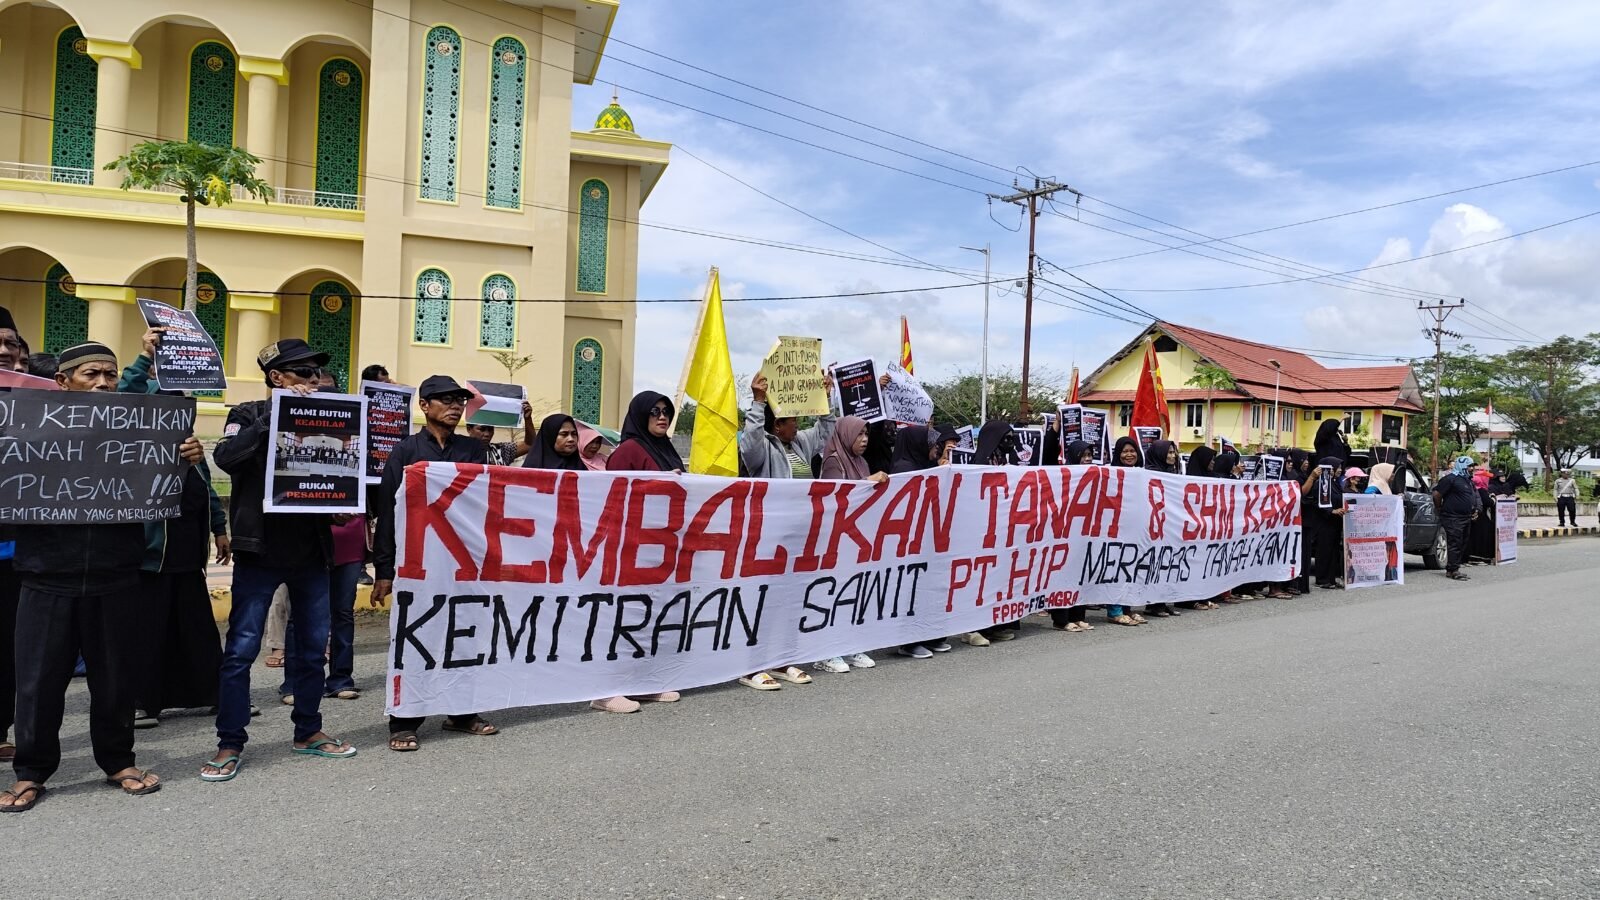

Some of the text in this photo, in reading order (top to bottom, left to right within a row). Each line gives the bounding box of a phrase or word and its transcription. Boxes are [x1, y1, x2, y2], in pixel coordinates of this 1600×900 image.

[778, 393, 808, 405] SCHEMES
[39, 404, 193, 431] KEMBALIKAN
[290, 407, 352, 418] KAMI BUTUH
[295, 418, 346, 428] KEADILAN
[0, 473, 135, 501] PLASMA
[299, 482, 335, 490] BUKAN
[286, 491, 346, 499] PESAKITAN
[0, 507, 78, 521] EMITRAAN
[83, 508, 114, 521] YANG
[398, 461, 963, 586] KEMBALIKAN
[980, 466, 1125, 549] TANAH
[1148, 479, 1166, 541] &
[1182, 483, 1236, 541] SHM
[394, 584, 769, 671] KEMITRAAN
[799, 562, 928, 633] SAWIT
[1078, 541, 1197, 585] MERAMPAS
[1202, 537, 1255, 580] TANAH
